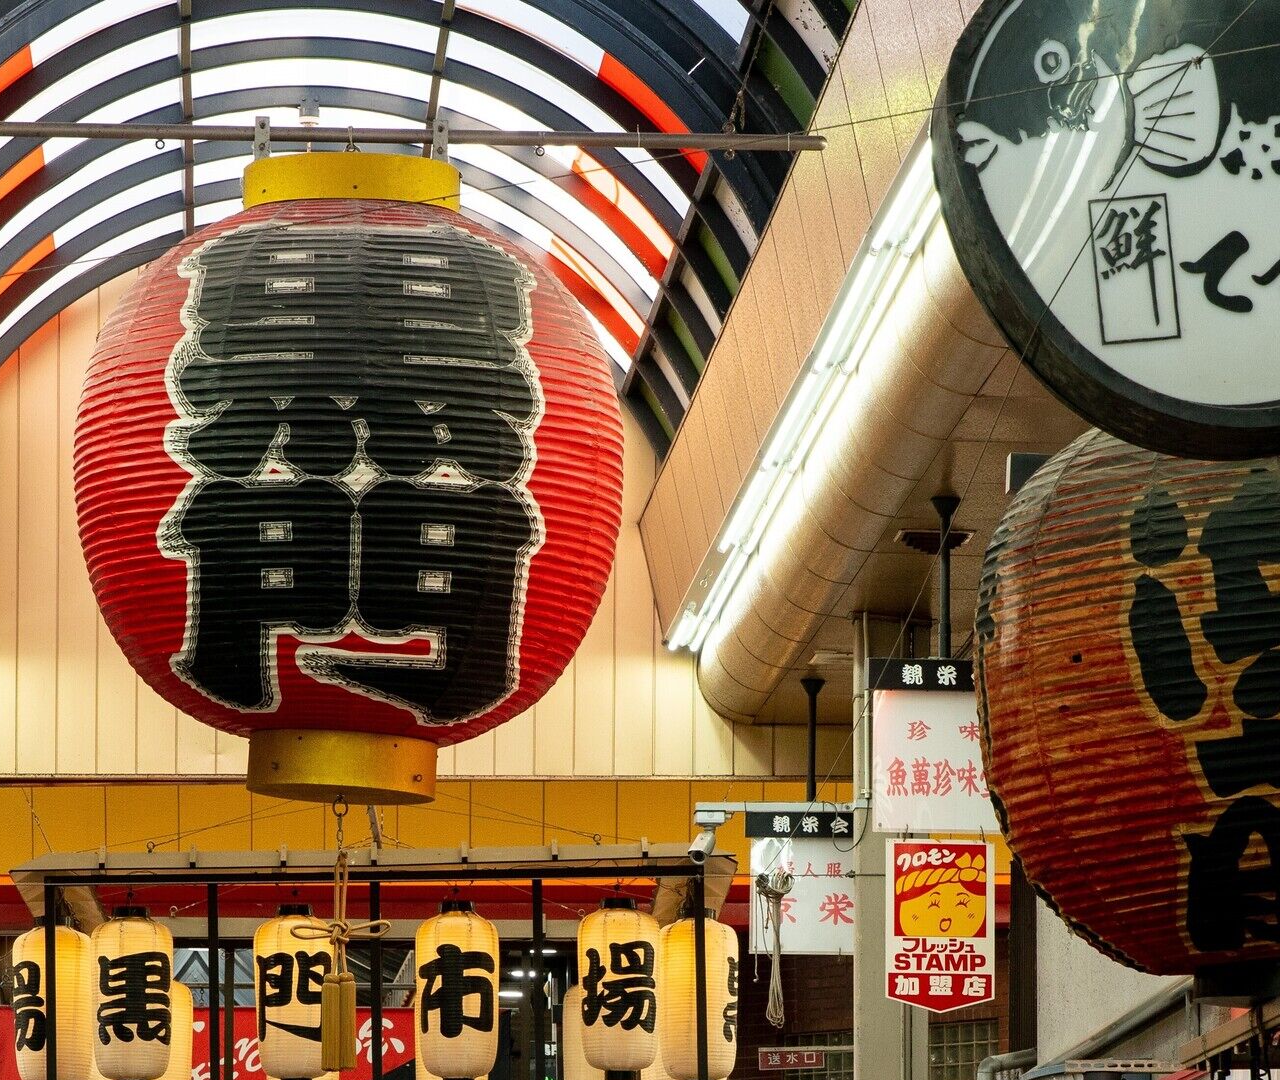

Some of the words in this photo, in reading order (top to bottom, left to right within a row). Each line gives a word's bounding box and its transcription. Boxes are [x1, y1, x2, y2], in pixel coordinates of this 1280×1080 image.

[902, 664, 976, 686] 親栄
[772, 815, 849, 833] 親栄会
[896, 848, 956, 867] クロモン
[902, 938, 976, 953] フレッシュ
[894, 954, 987, 972] STAMP
[895, 975, 987, 997] 加盟店
[767, 1052, 817, 1065] 送水口
